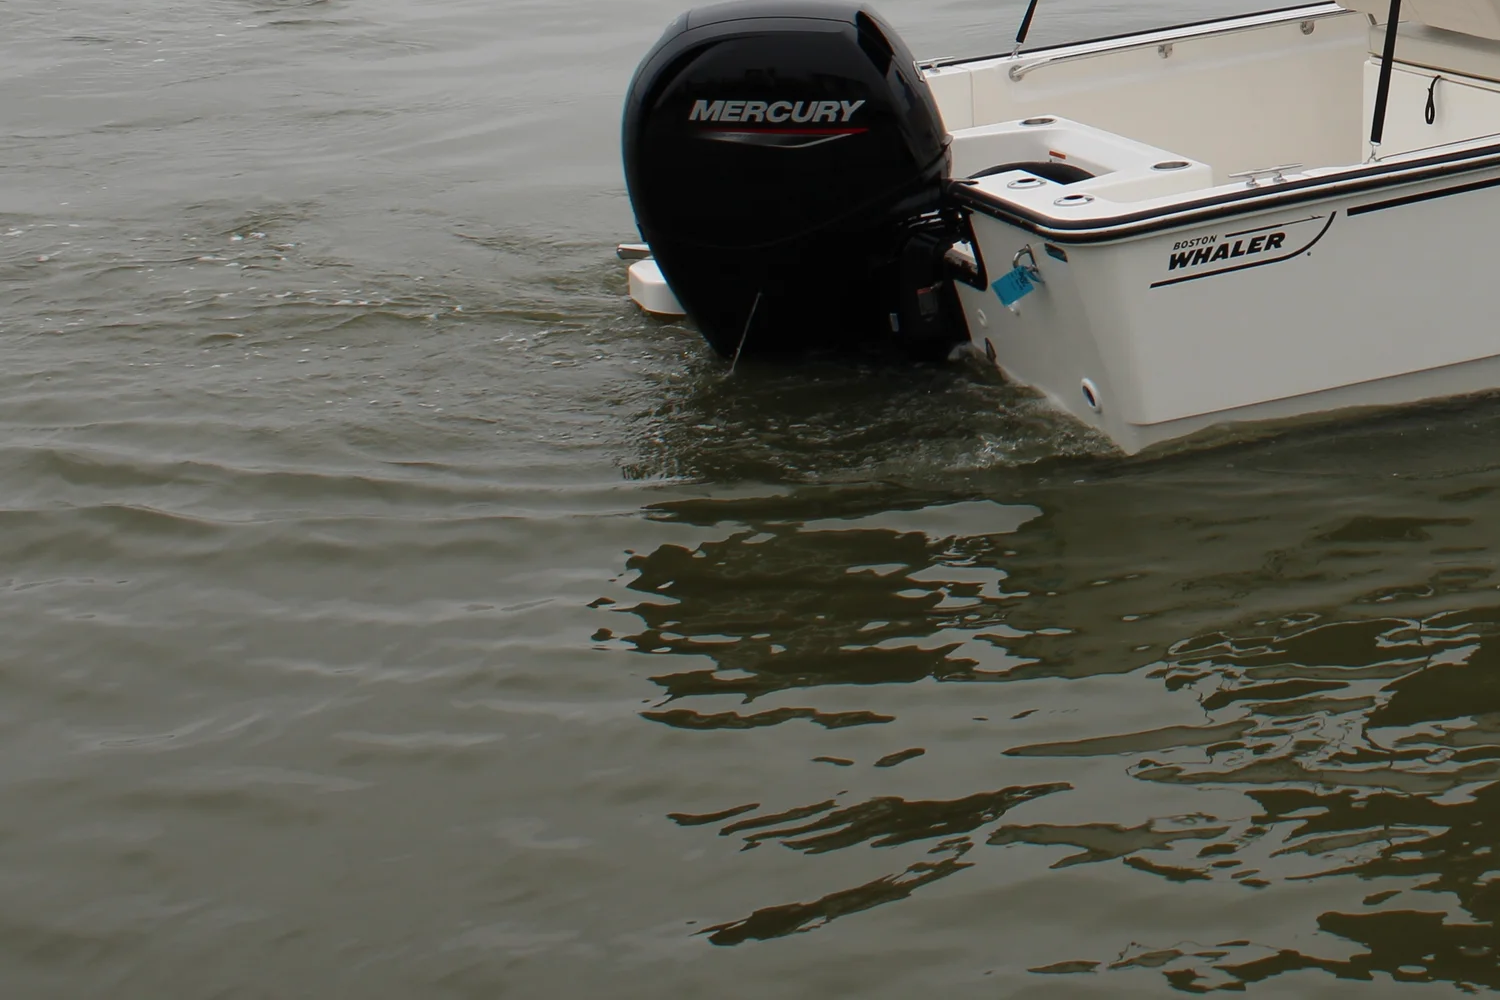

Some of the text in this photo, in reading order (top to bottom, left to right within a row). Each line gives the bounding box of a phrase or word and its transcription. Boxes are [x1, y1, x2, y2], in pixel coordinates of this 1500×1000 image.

[688, 99, 866, 123] MERCURY
[1168, 232, 1286, 271] WHALER
[1173, 234, 1218, 251] BOSTON
